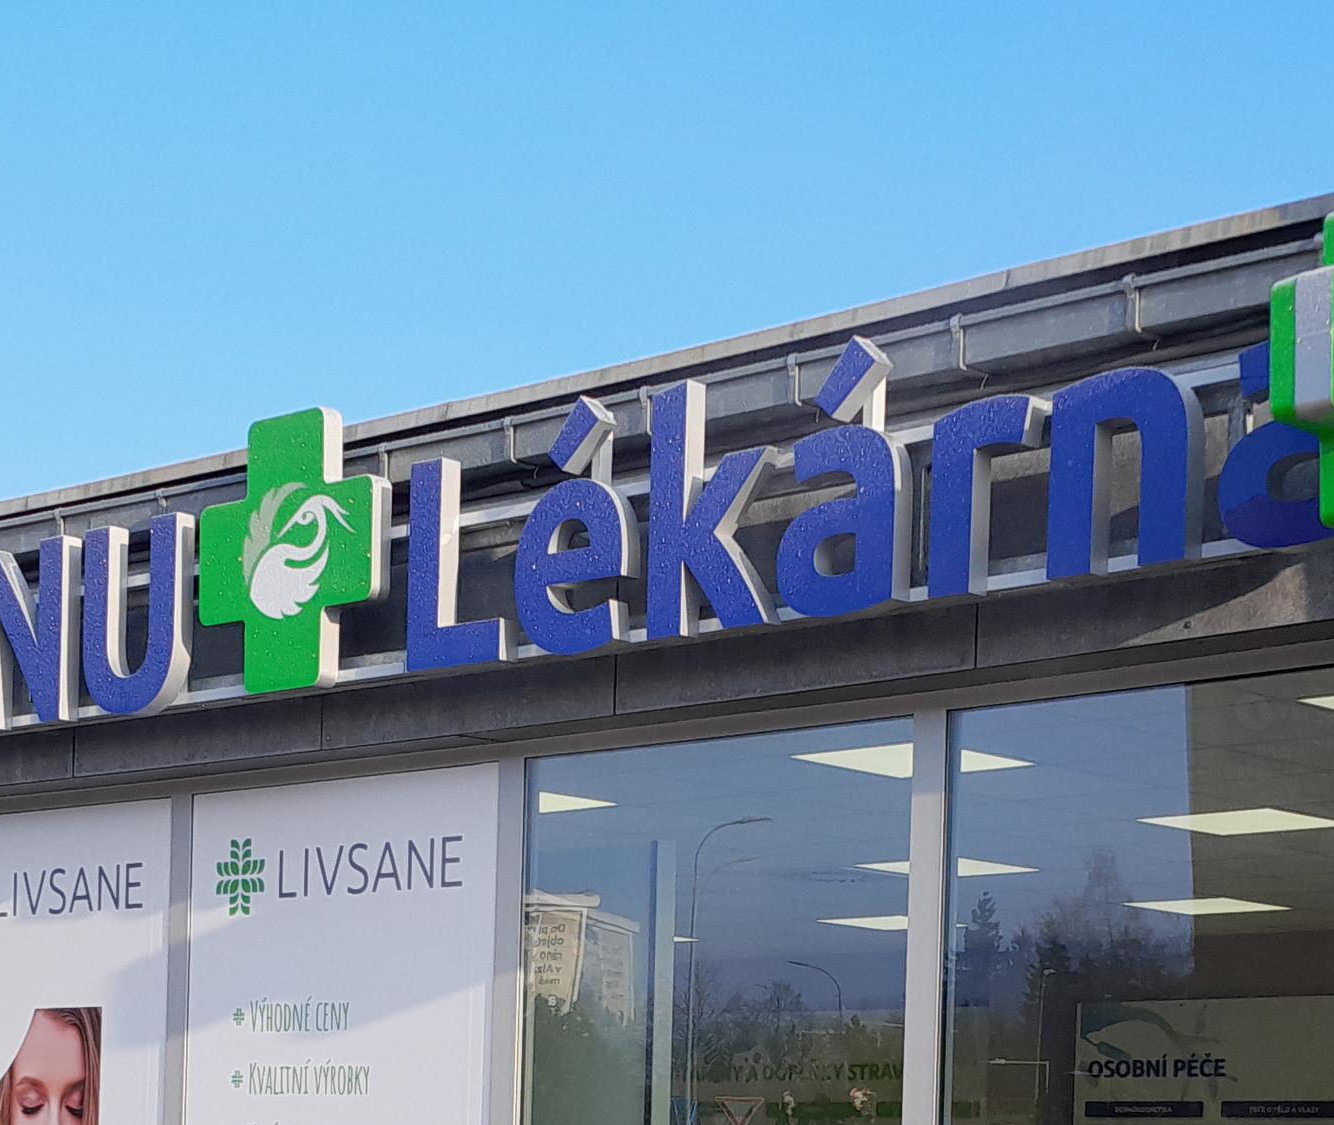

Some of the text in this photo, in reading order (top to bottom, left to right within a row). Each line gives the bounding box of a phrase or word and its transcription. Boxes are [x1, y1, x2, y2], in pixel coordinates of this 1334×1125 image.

[277, 835, 464, 899] LIVSANE
[1088, 1053, 1227, 1079] OSOBNÍ PÉČE
